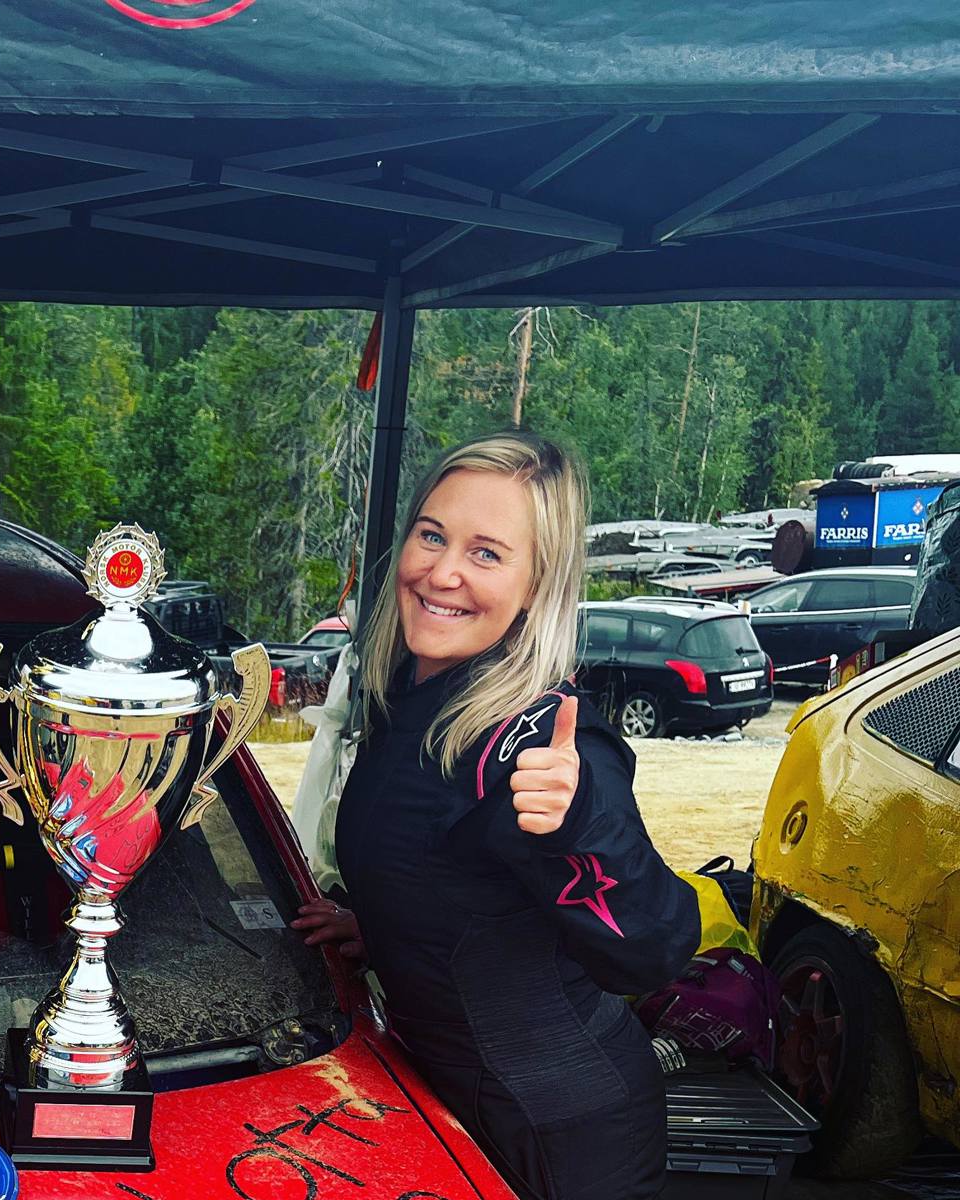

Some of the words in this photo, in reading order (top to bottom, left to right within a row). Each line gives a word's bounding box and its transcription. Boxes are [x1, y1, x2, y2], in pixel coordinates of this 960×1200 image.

[820, 527, 868, 540] FARRIS
[883, 523, 925, 538] FAR
[111, 543, 142, 554] MOTOR
[100, 556, 110, 588] NORSK
[110, 566, 138, 577] NMK
